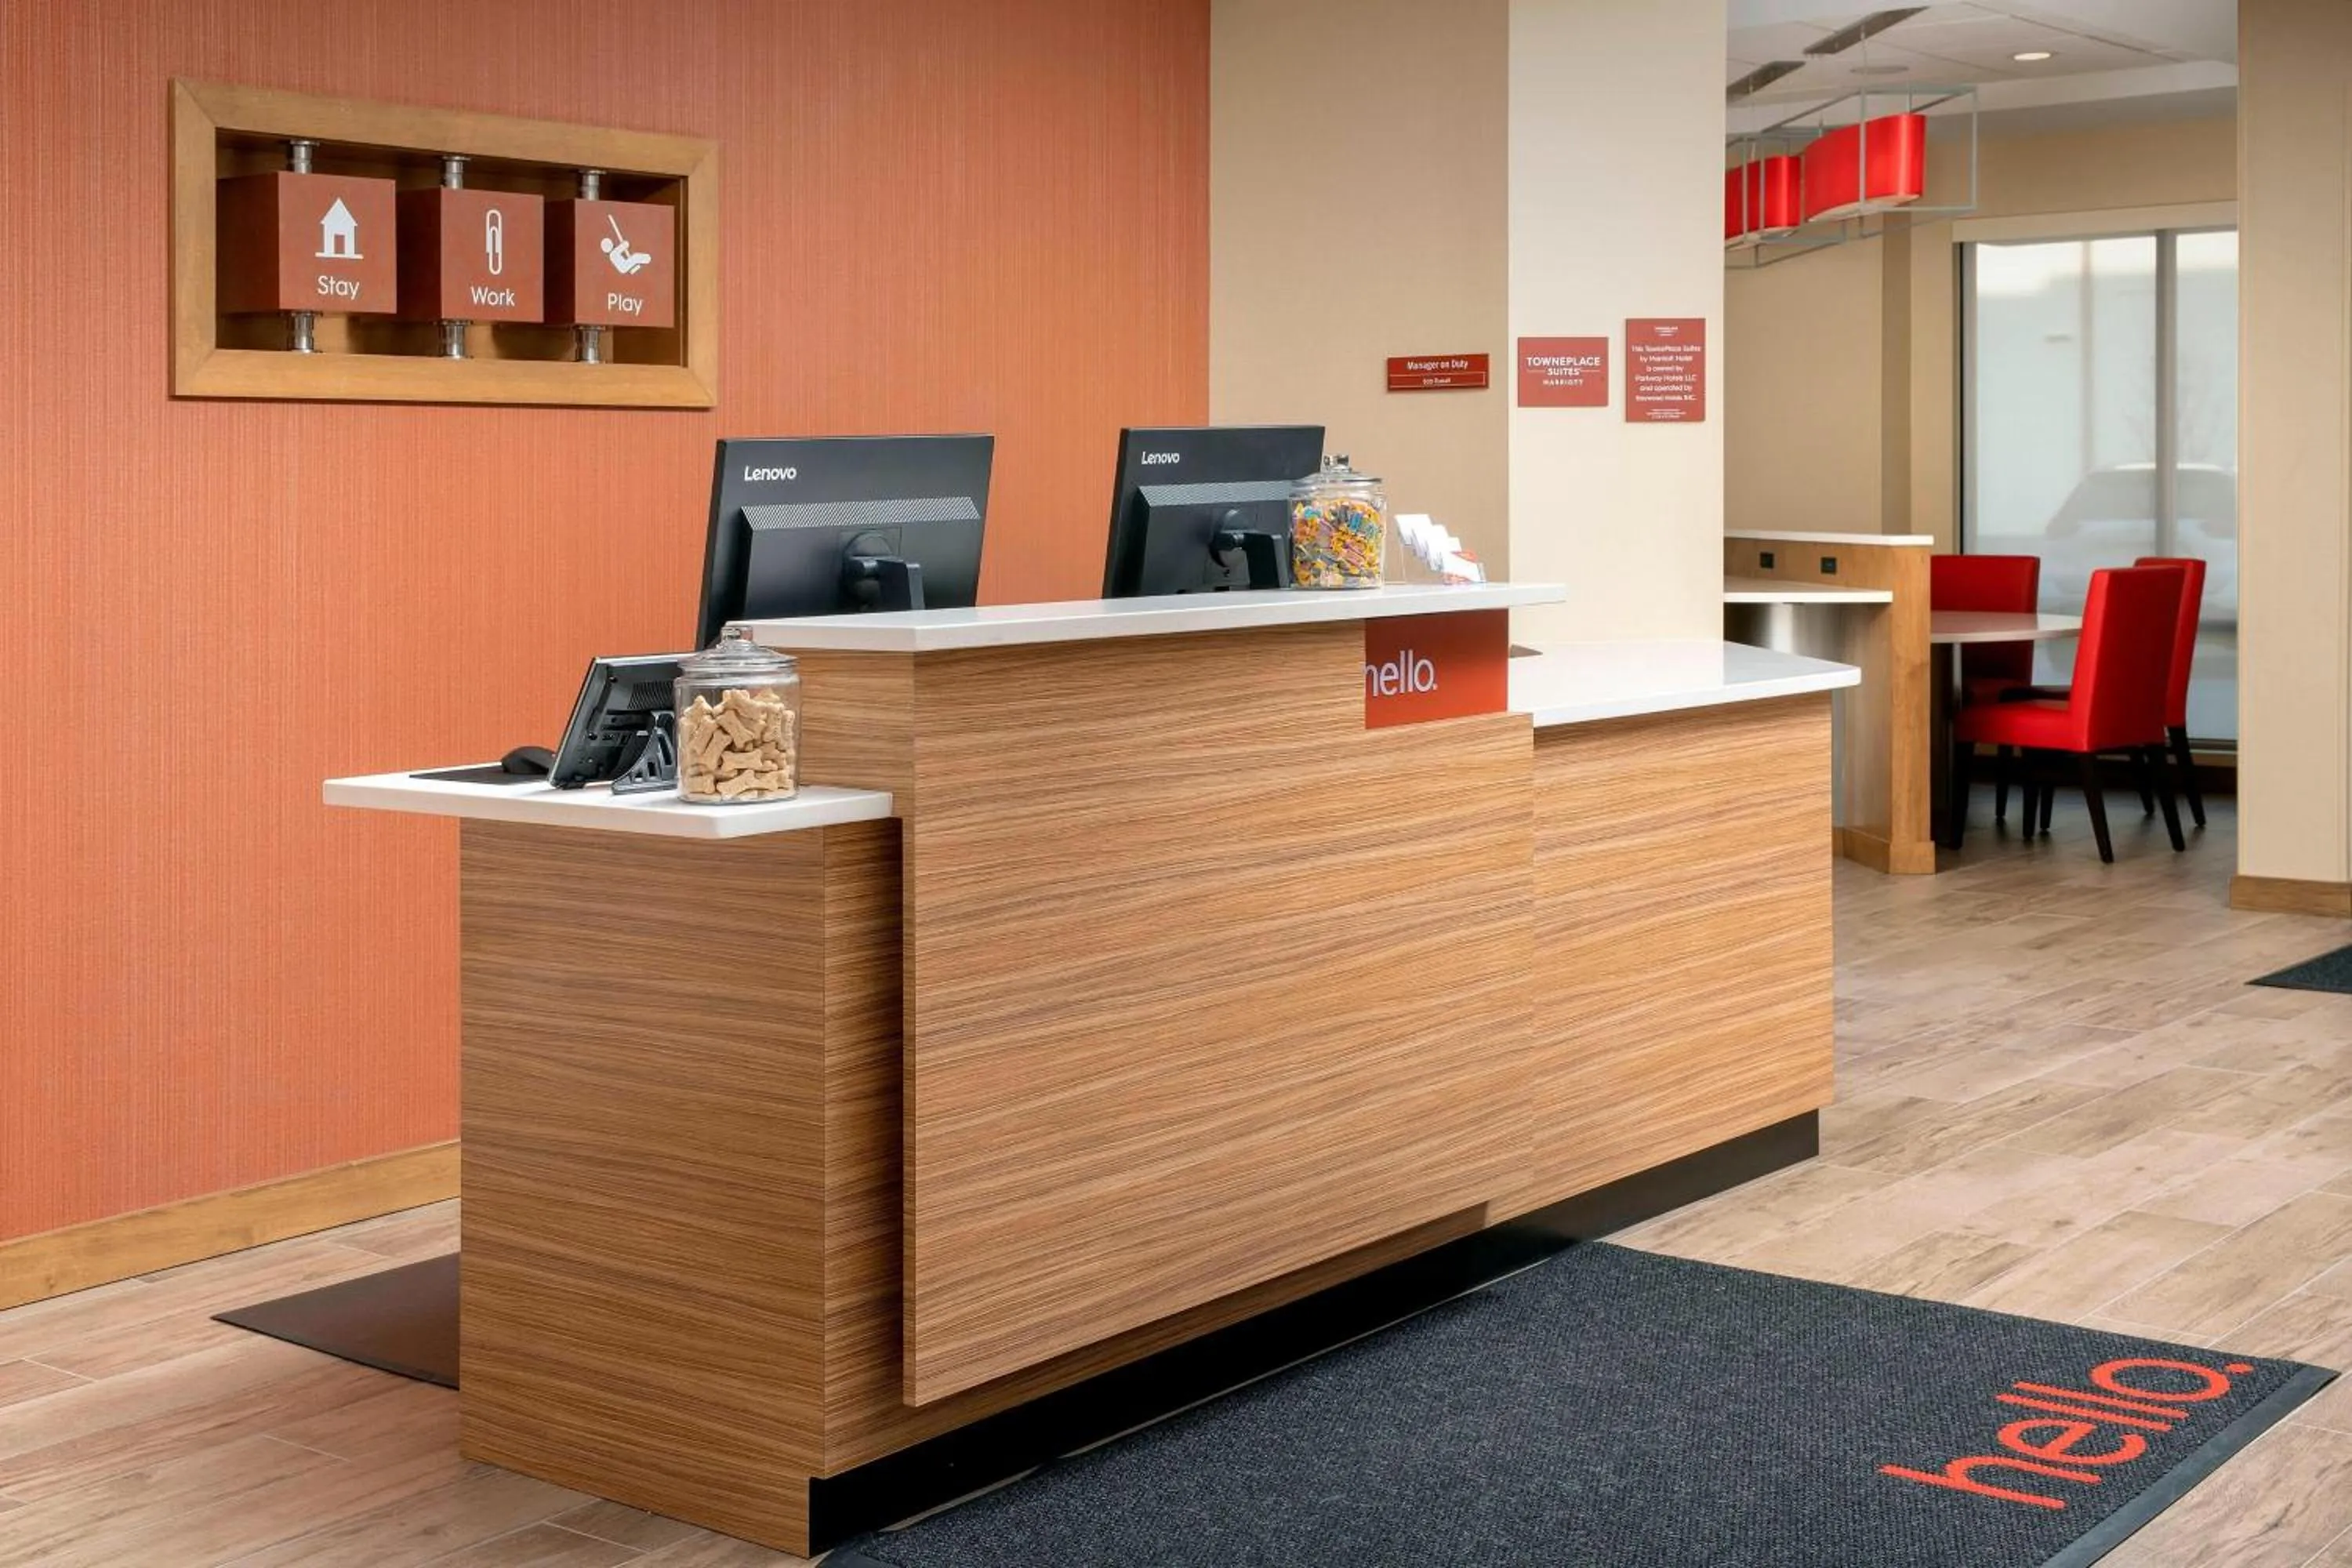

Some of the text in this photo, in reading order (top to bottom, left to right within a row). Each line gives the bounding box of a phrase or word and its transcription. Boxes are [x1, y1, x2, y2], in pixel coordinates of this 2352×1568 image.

[317, 274, 360, 300] Stay
[470, 285, 516, 307] Work
[607, 292, 644, 316] Play
[1406, 359, 1469, 371] Manager on Duty
[1526, 356, 1601, 367] TOWNEPLACE
[1547, 367, 1581, 376] SUITES
[1141, 451, 1180, 465] Lenovo
[744, 465, 797, 481] Lenovo
[1879, 1356, 2255, 1510] hello.
